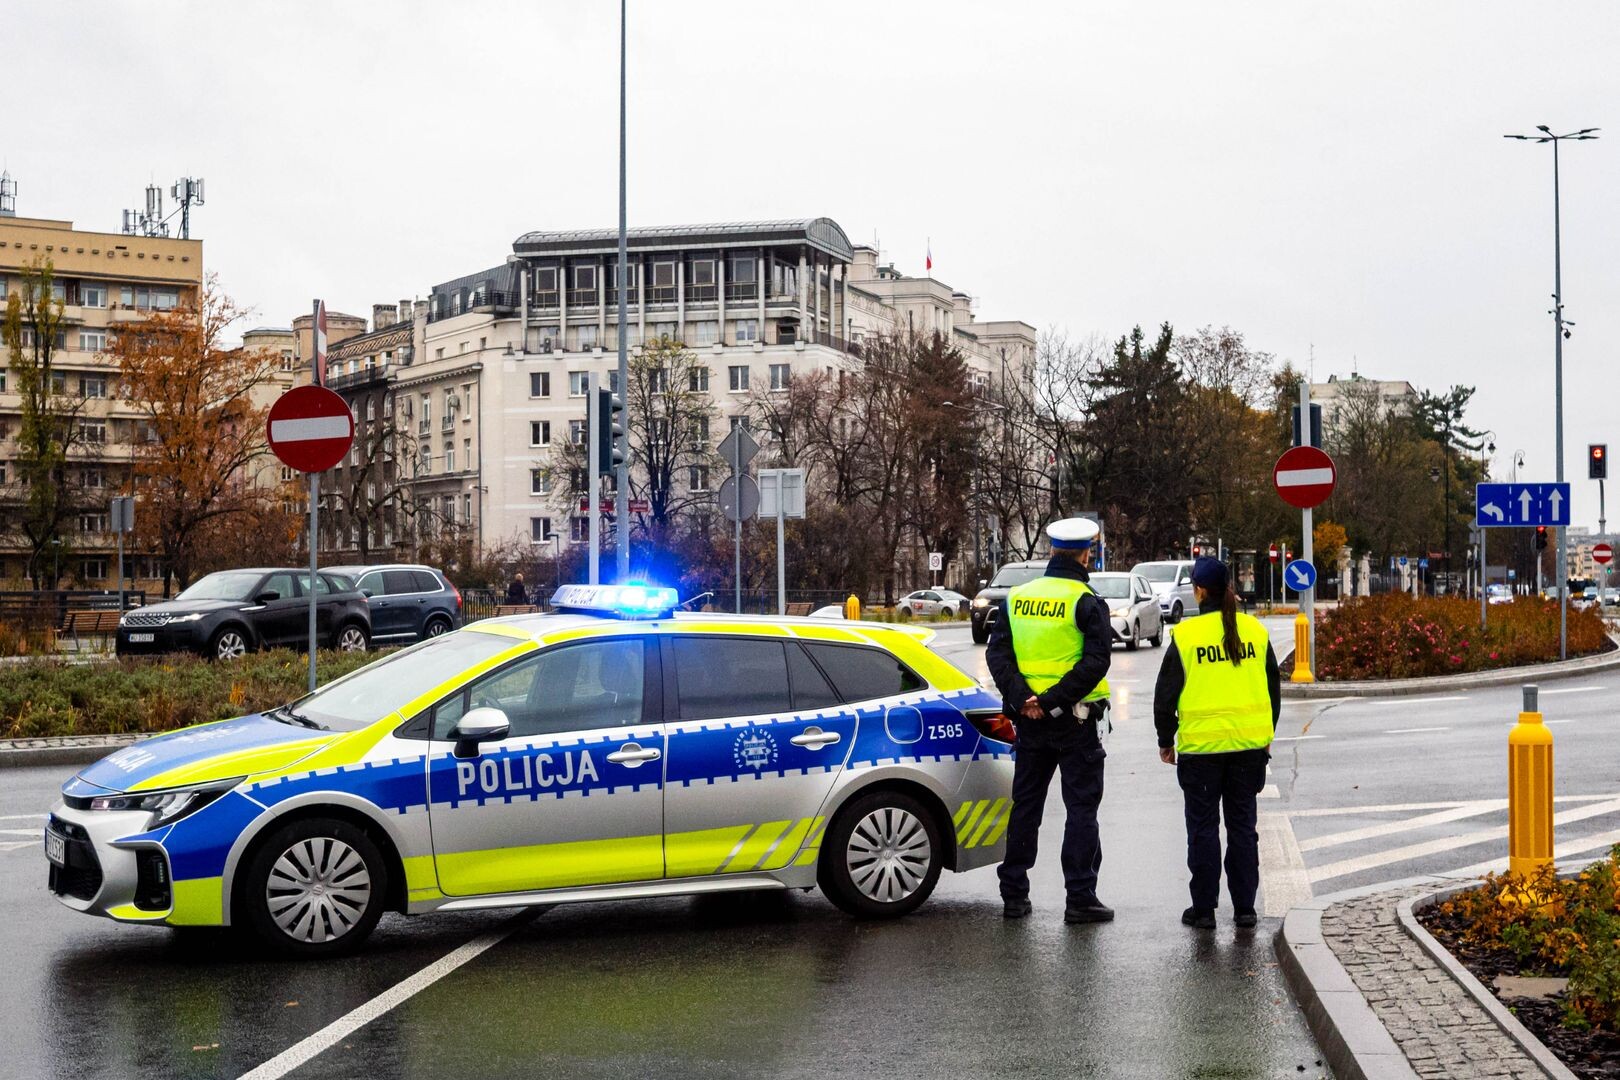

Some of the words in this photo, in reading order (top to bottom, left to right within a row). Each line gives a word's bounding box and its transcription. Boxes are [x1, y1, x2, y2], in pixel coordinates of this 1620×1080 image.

[1013, 599, 1066, 619] POLICJA
[1196, 641, 1256, 664] POLIJA
[928, 723, 964, 740] Z585
[456, 750, 600, 796] POLICJA
